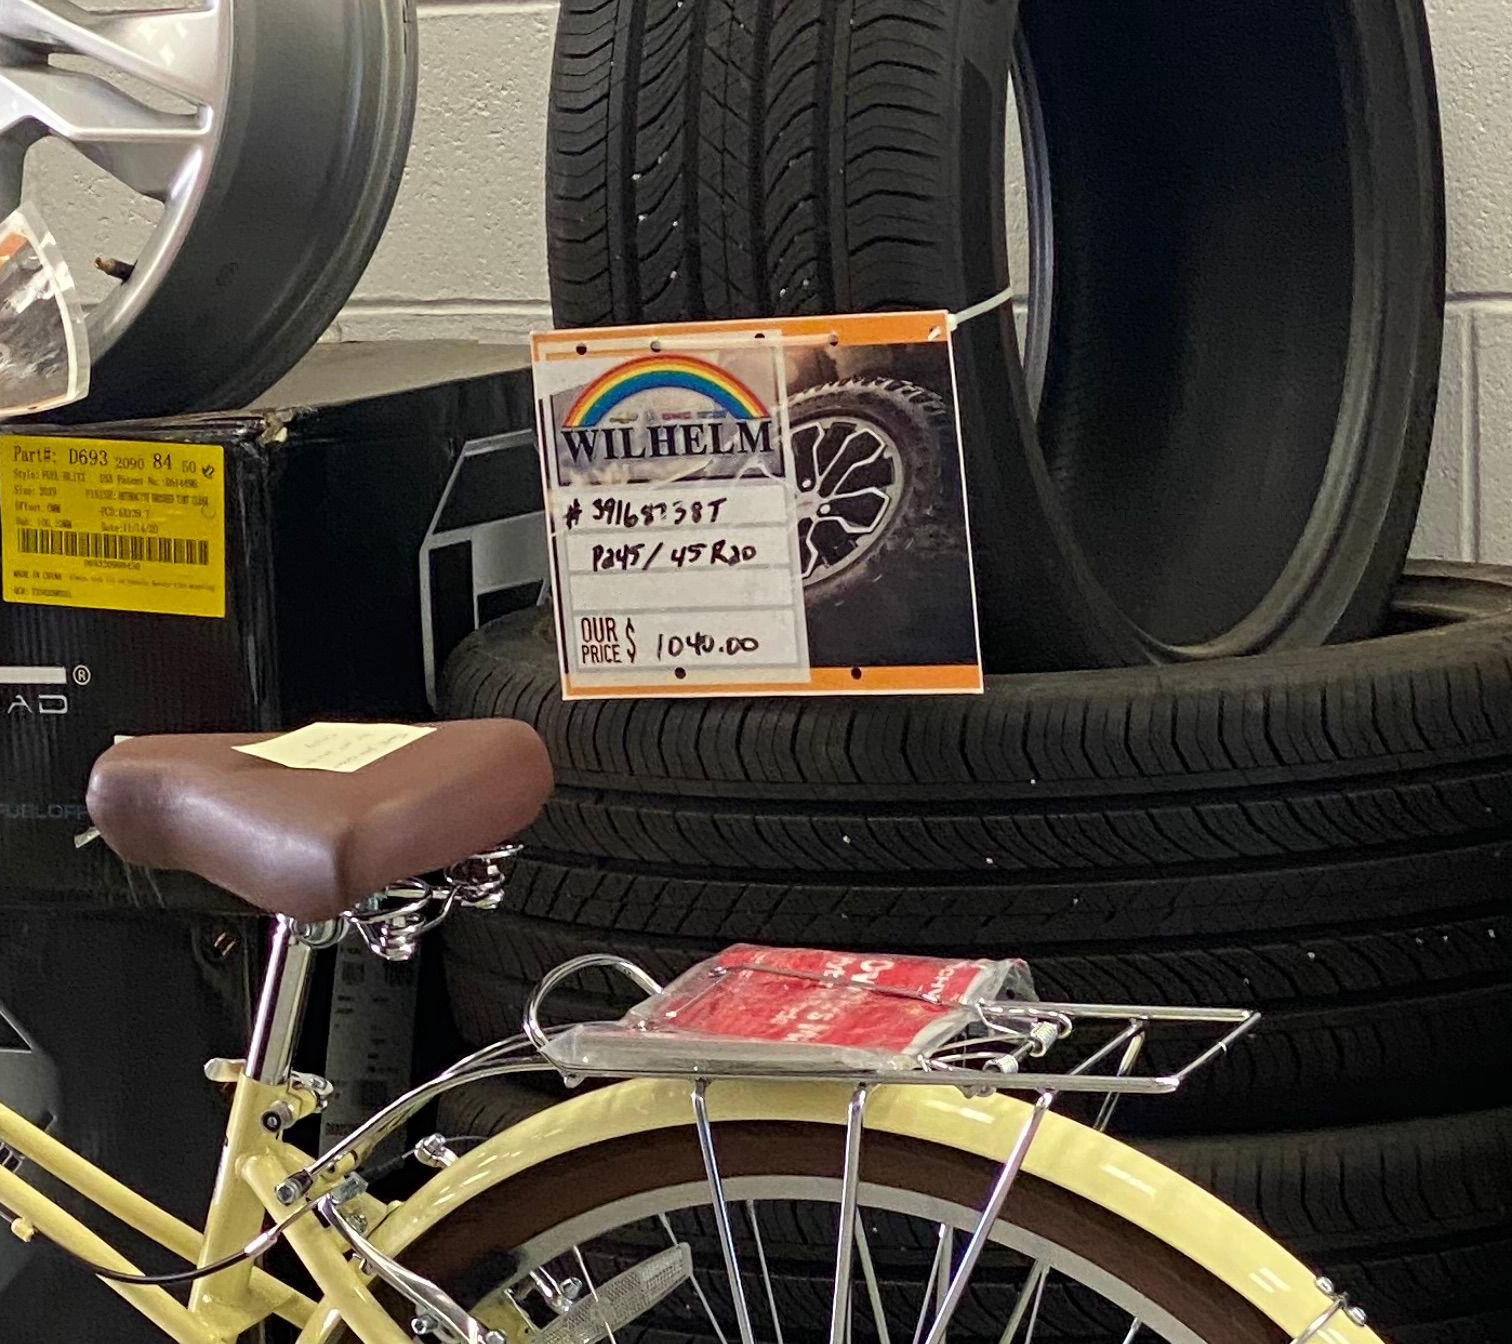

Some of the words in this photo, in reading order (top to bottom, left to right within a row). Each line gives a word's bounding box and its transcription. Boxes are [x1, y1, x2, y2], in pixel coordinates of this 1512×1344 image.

[561, 421, 774, 463] WILHELM
[69, 448, 108, 466] D693
[114, 456, 146, 471] 2090
[152, 452, 173, 470] 84
[563, 498, 583, 530] #
[581, 617, 619, 643] OUR
[625, 617, 637, 664] $
[657, 631, 760, 662] 1040.00
[581, 644, 623, 664] PRICE
